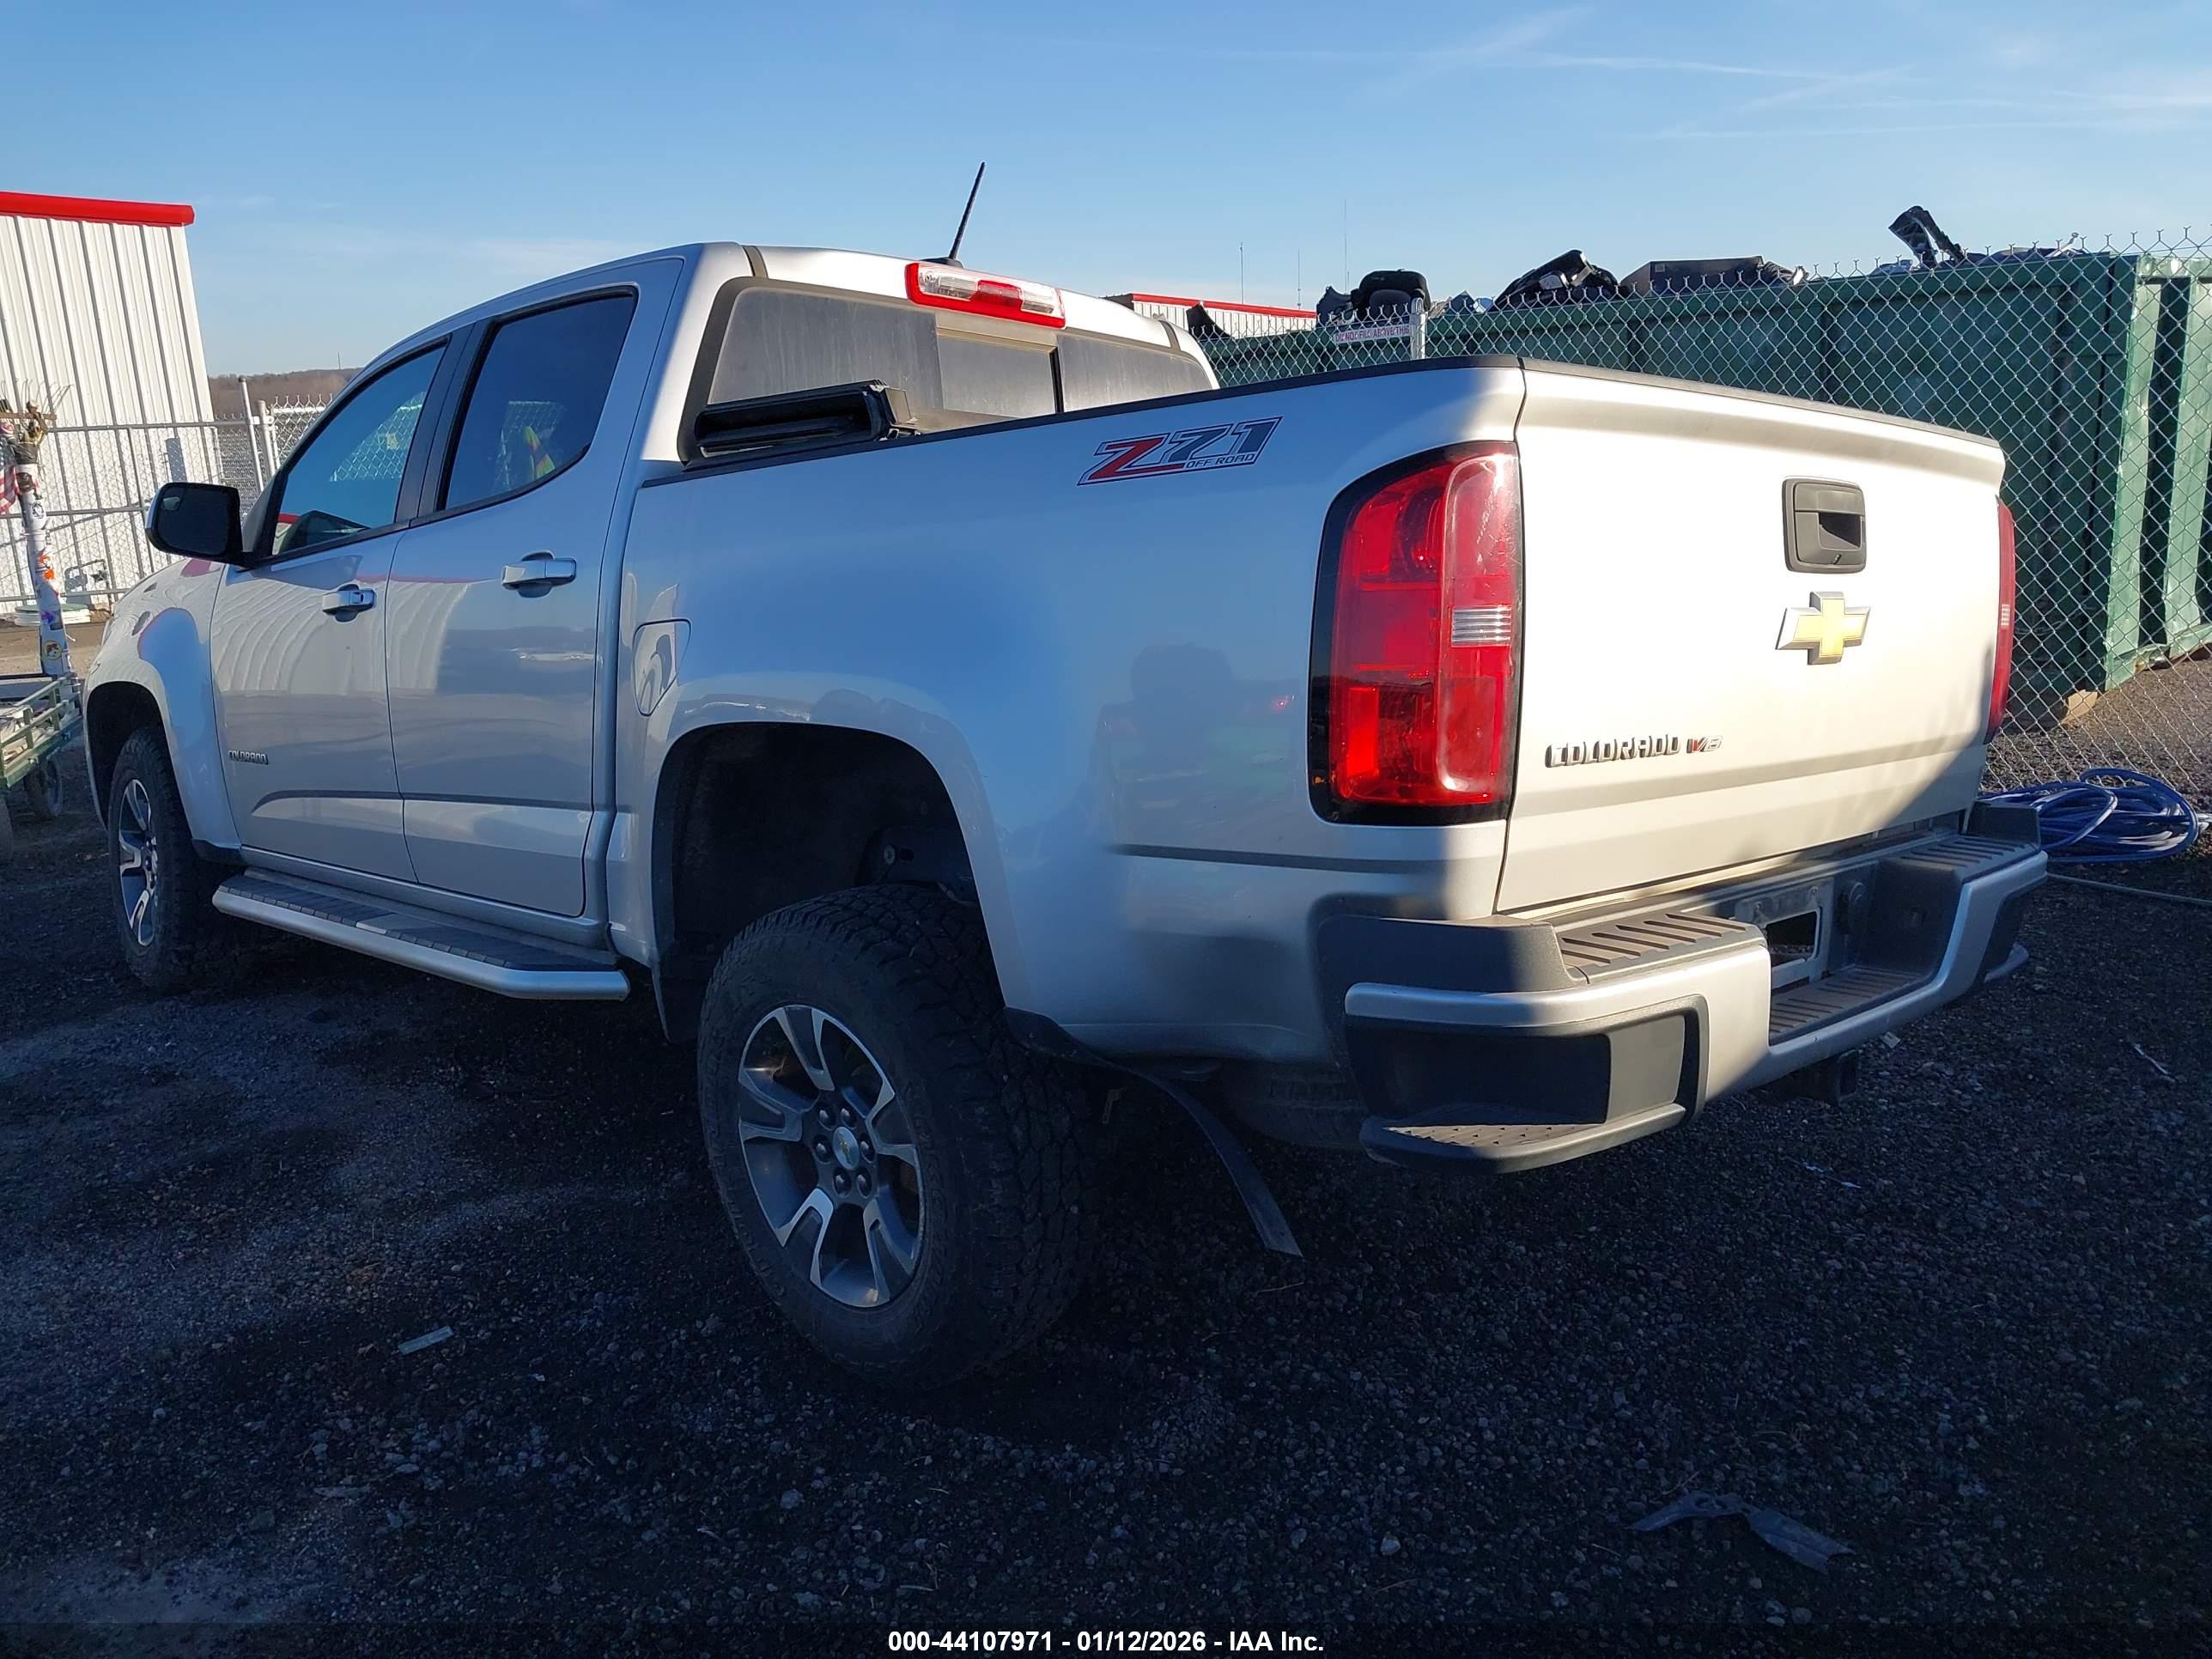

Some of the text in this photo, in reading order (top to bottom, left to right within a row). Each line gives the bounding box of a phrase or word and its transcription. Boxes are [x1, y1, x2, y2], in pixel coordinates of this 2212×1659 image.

[1373, 328, 1394, 337] ABOVE
[1077, 416, 1284, 485] Z71
[1186, 453, 1255, 469] OFF ROAD
[1545, 733, 1723, 768] COLORADO V6
